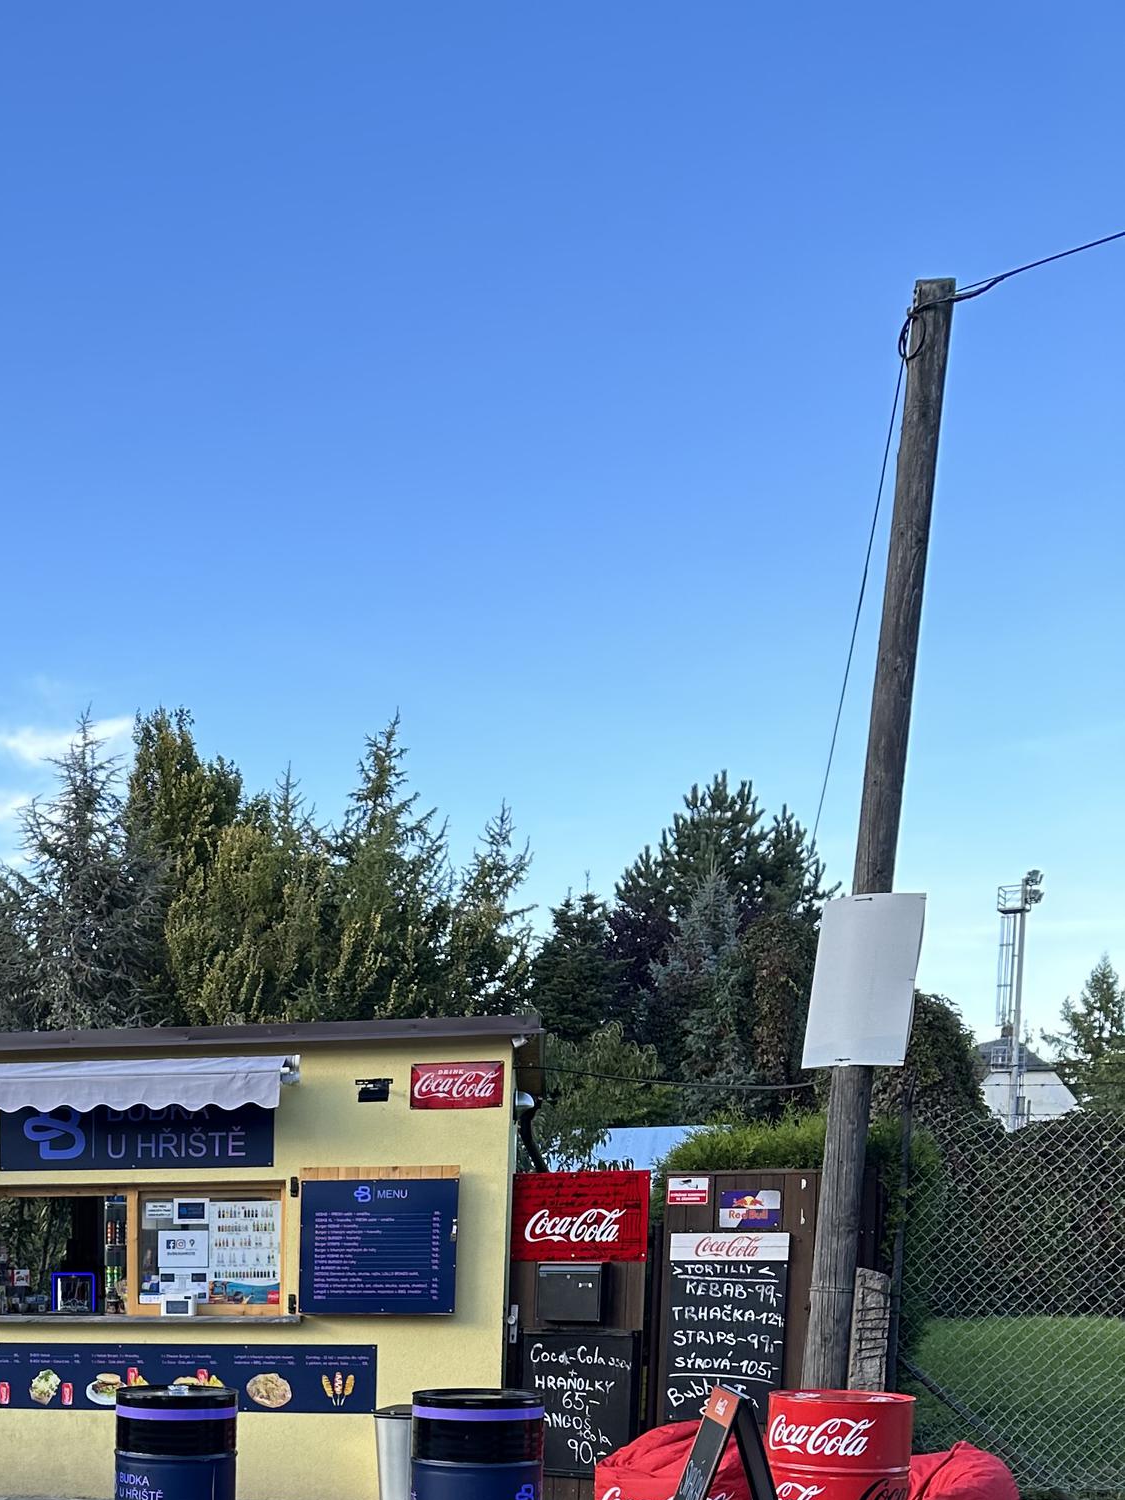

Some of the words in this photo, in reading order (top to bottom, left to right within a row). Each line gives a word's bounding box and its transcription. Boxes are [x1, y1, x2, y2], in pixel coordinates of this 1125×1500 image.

[414, 1071, 499, 1099] Coca-Cola
[107, 1134, 125, 1159] U
[137, 1126, 246, 1158] HŘIŠTĚ
[377, 1189, 408, 1199] MENU
[728, 1209, 748, 1219] Red
[524, 1208, 627, 1243] Coca-Cola
[695, 1236, 763, 1257] Coca-Cola
[769, 1414, 877, 1457] Coca-Cola
[119, 1472, 150, 1487] BUDKA
[119, 1487, 124, 1498] U
